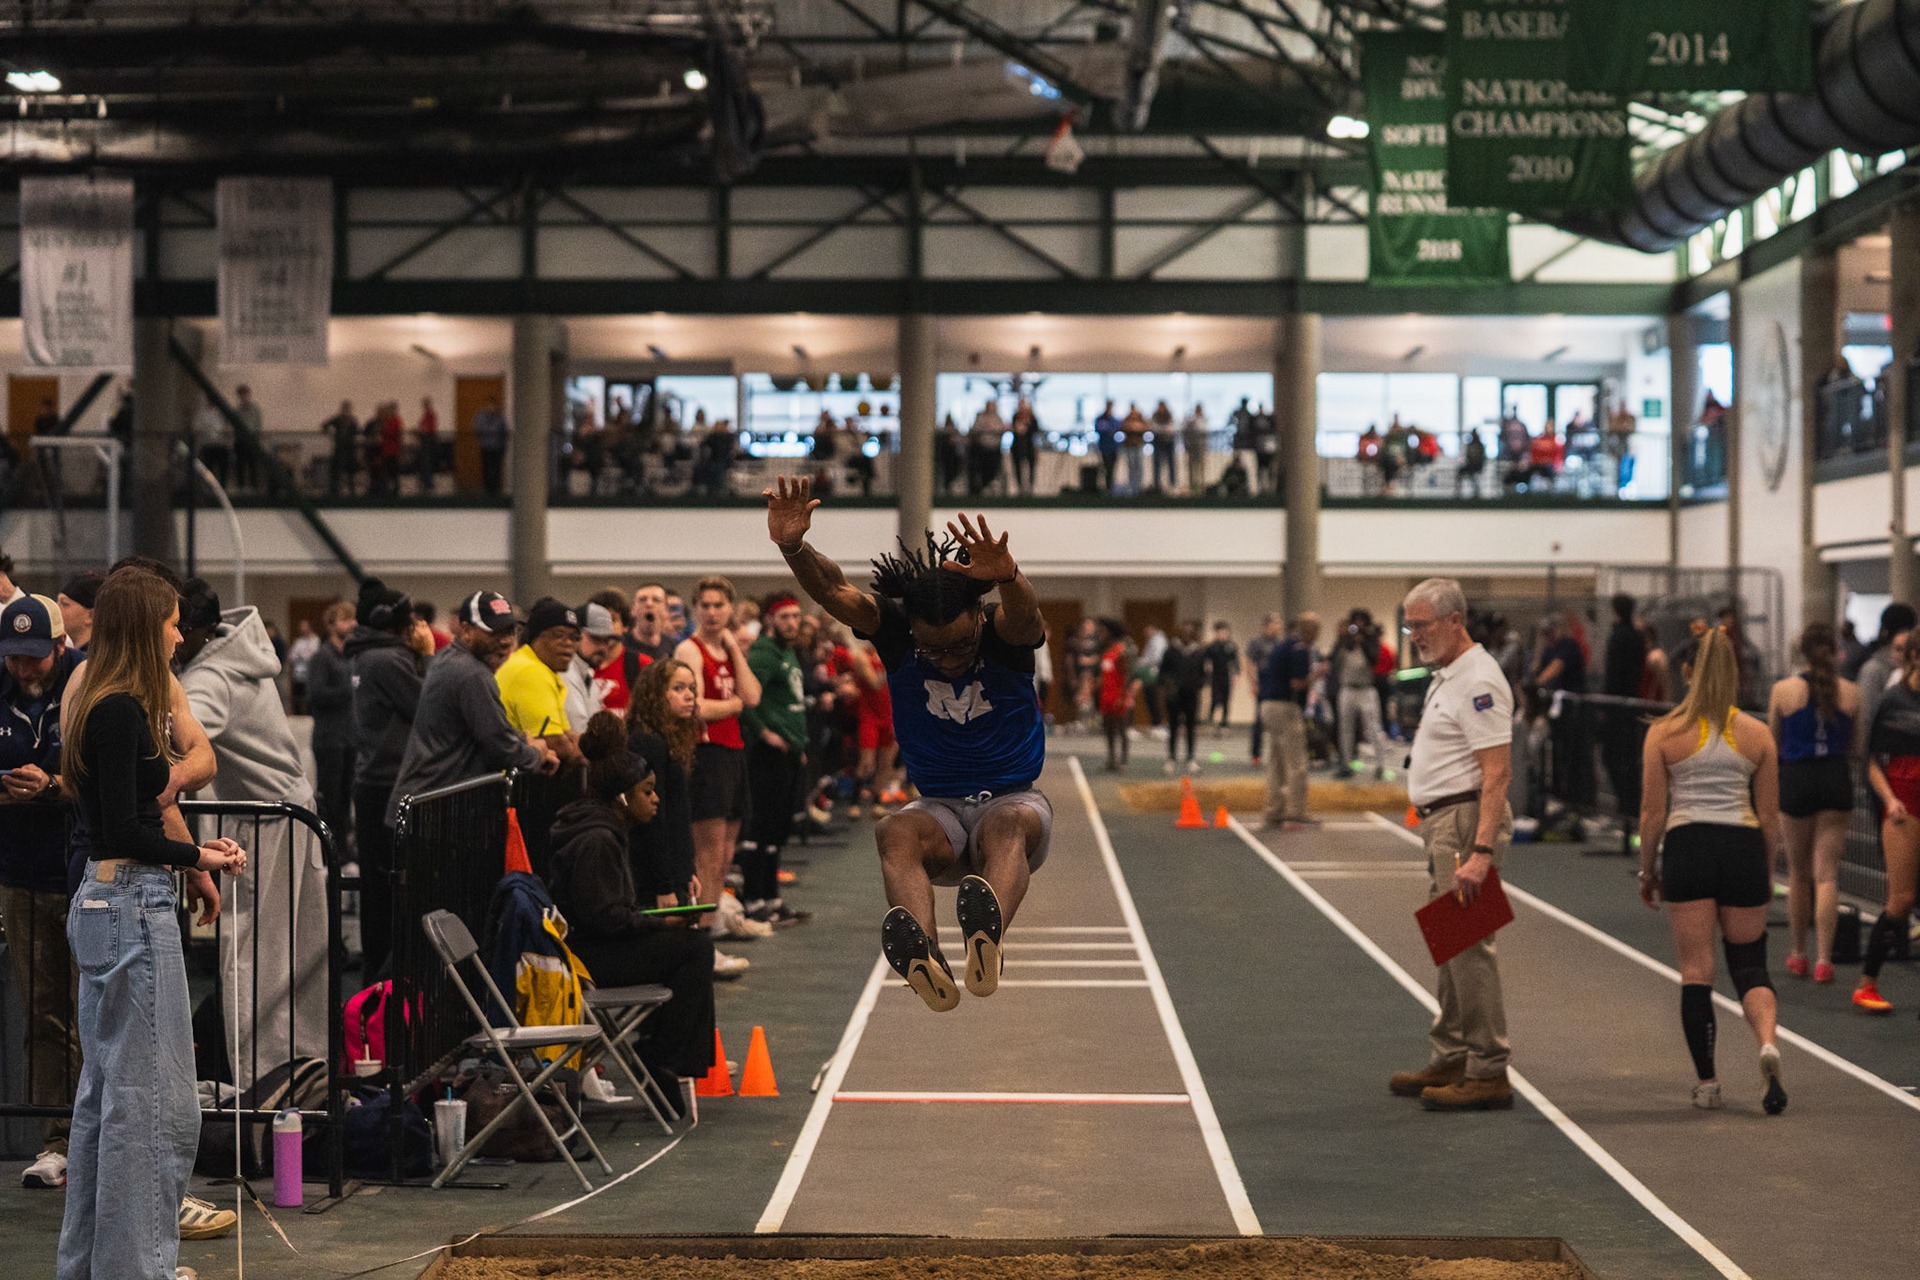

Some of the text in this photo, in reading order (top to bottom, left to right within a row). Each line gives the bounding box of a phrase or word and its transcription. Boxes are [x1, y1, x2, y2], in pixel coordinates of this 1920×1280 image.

[1646, 31, 1730, 65] 2014
[1453, 110, 1626, 138] CHAMPIONS
[1507, 155, 1574, 183] 2010
[924, 680, 993, 725] M
